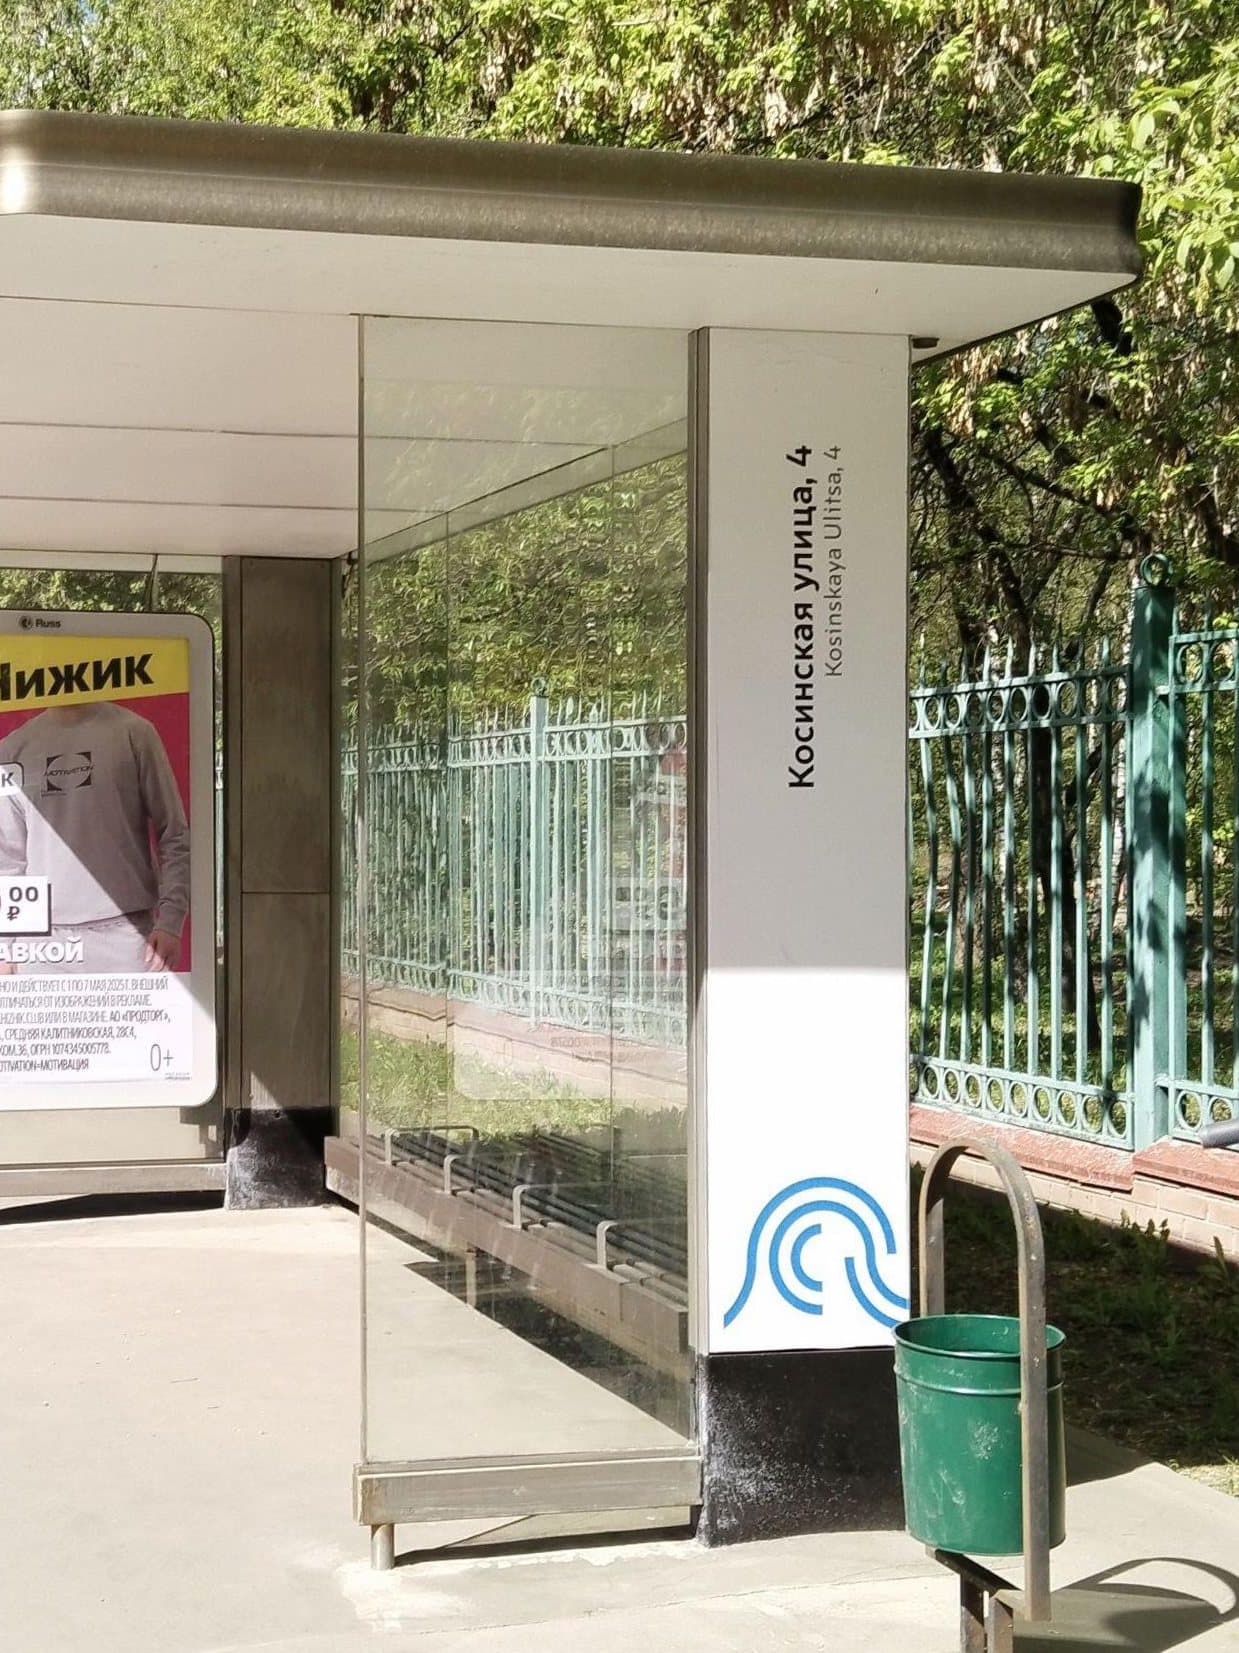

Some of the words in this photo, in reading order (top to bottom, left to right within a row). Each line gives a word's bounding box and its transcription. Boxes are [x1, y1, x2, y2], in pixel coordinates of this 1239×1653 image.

[786, 445, 812, 467] 4
[824, 445, 842, 461] 4
[823, 467, 845, 540] Ulitsa,
[792, 477, 819, 592] улица,
[36, 618, 61, 628] Russ
[824, 547, 847, 677] Kosinskaya
[788, 602, 814, 787] Косинская
[9, 887, 38, 902] 00
[150, 1044, 174, 1071] 0+
